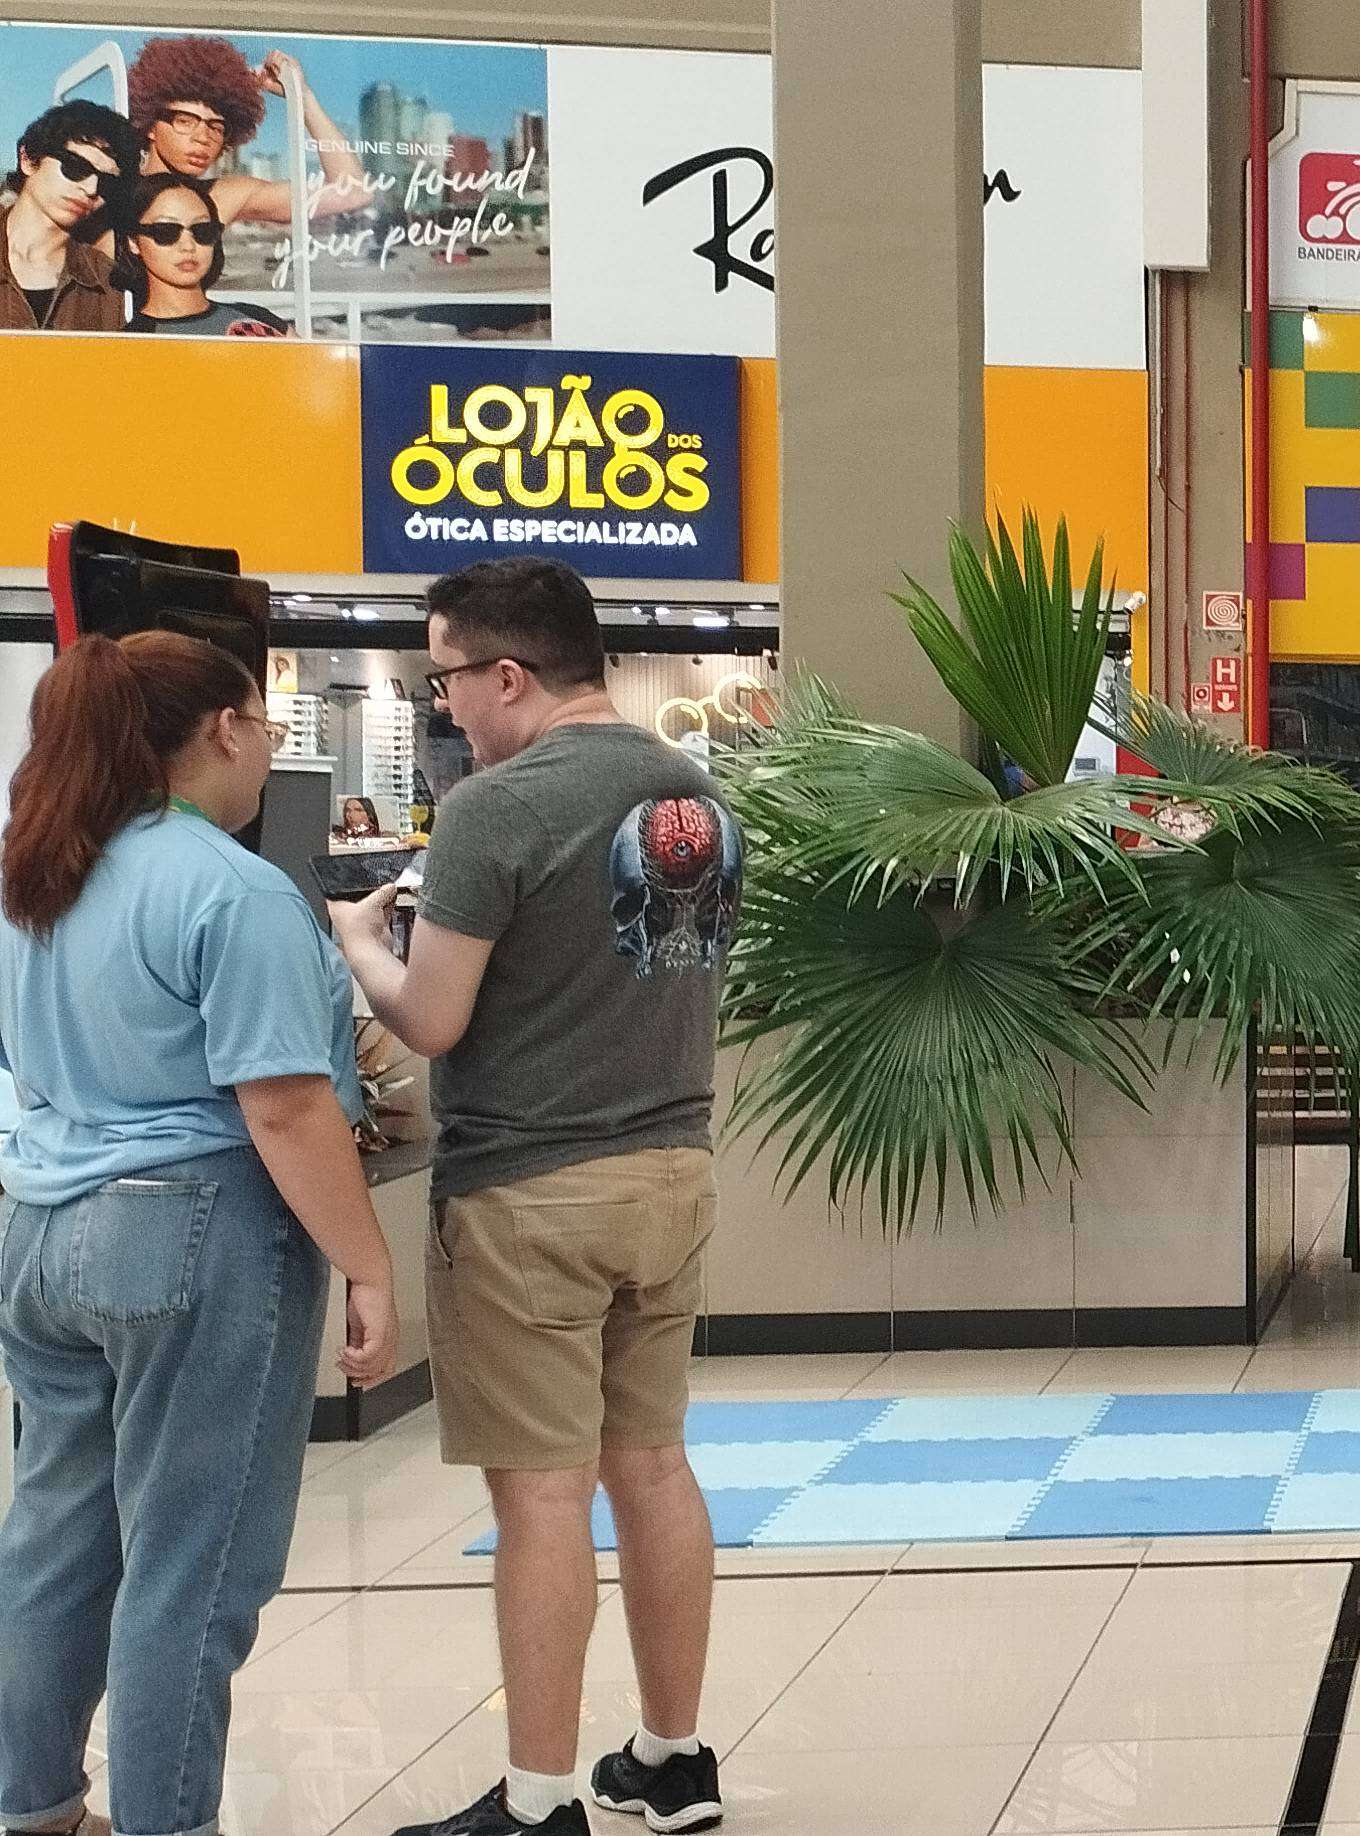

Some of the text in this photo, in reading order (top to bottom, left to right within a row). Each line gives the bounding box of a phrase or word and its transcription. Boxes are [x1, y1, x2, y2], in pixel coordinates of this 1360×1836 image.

[304, 139, 455, 158] GENUINE SINCE
[306, 147, 536, 220] you found
[271, 195, 515, 289] your people
[430, 374, 705, 457] LOJÃO DOS
[390, 434, 711, 512] ÓCULOS
[403, 511, 698, 547] ÓTICA ESPECIALIZADA
[1216, 658, 1236, 684] H
